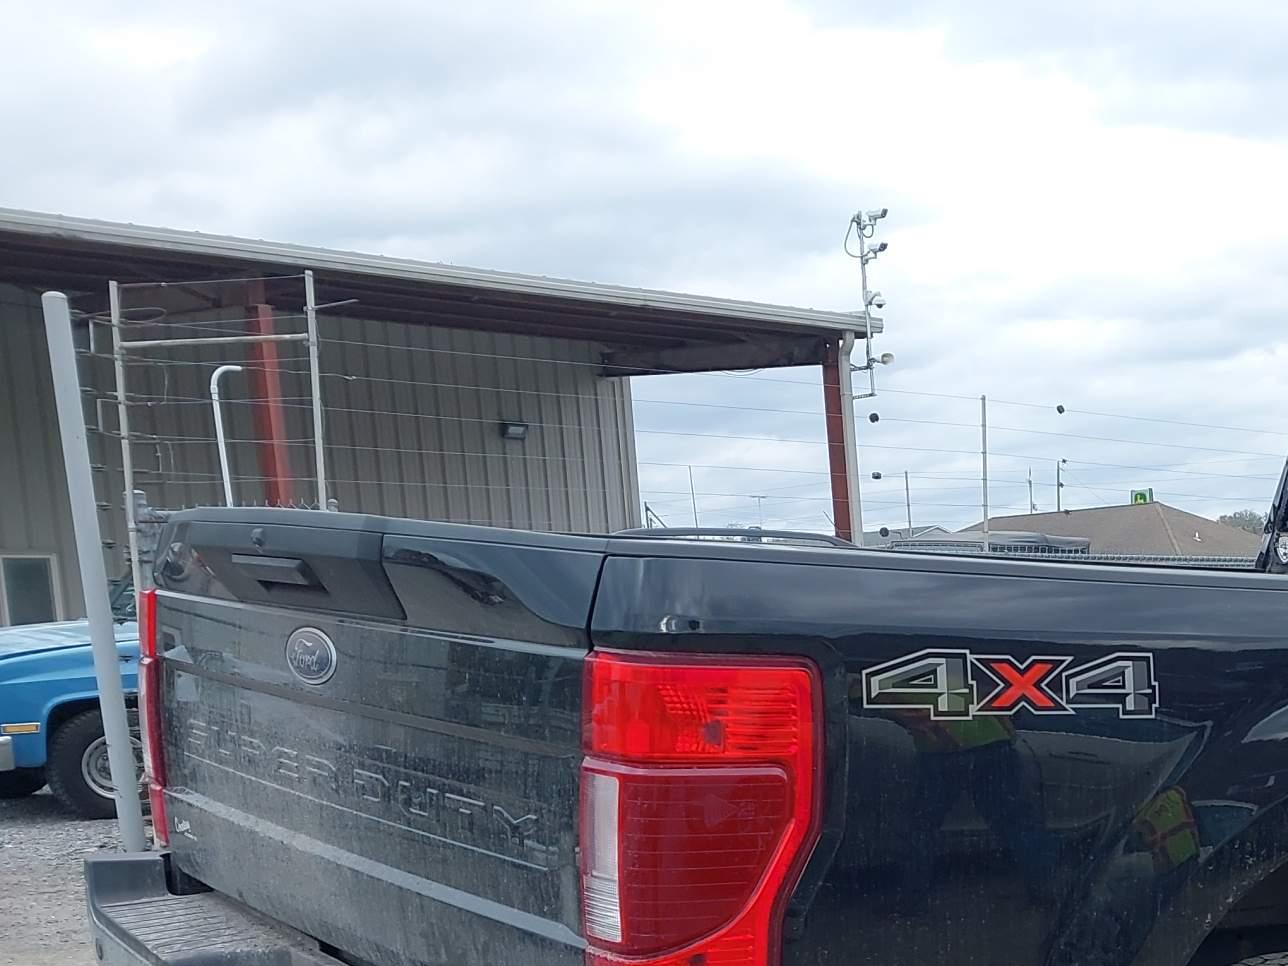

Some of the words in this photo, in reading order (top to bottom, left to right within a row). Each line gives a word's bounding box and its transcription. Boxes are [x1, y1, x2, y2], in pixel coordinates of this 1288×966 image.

[290, 638, 321, 672] Ford
[186, 718, 339, 788] SUPER
[352, 766, 539, 848] DUTY
